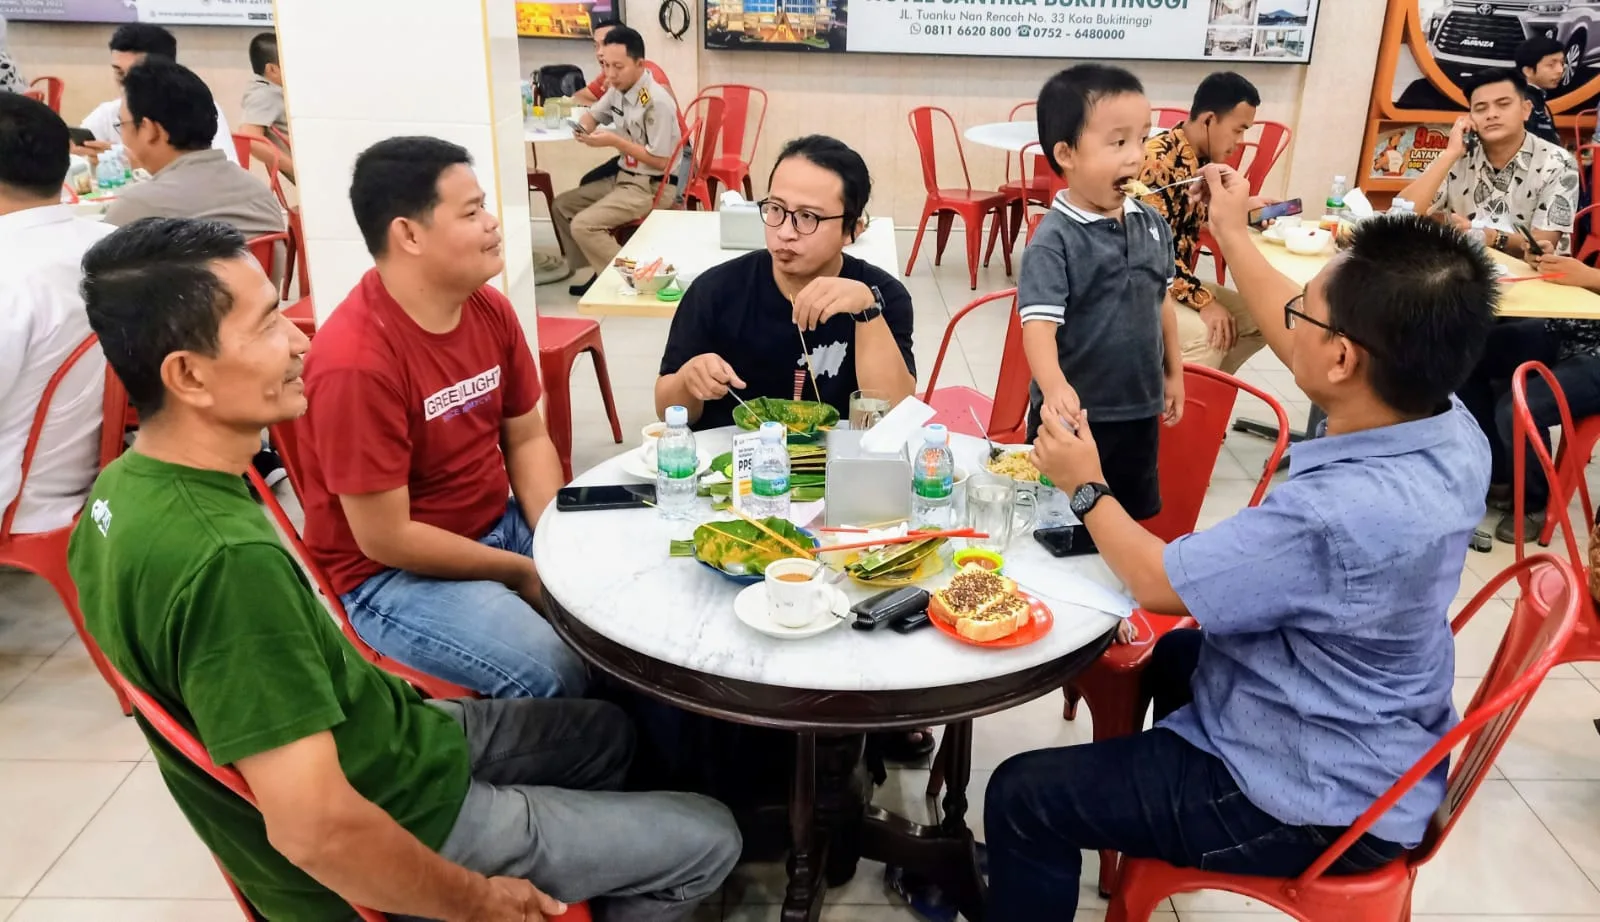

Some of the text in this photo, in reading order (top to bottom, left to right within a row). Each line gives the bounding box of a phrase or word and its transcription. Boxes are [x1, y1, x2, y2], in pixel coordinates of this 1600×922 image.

[899, 9, 1152, 27] JL. Tuanku Nan Renceh No. 33 Kota Bukittinggi
[924, 25, 952, 35] 0811
[957, 26, 986, 36] 6620
[990, 26, 1011, 37] 800
[1033, 27, 1062, 38] 0752
[1074, 28, 1125, 40] 6480000
[426, 370, 499, 416] GREELIGHT
